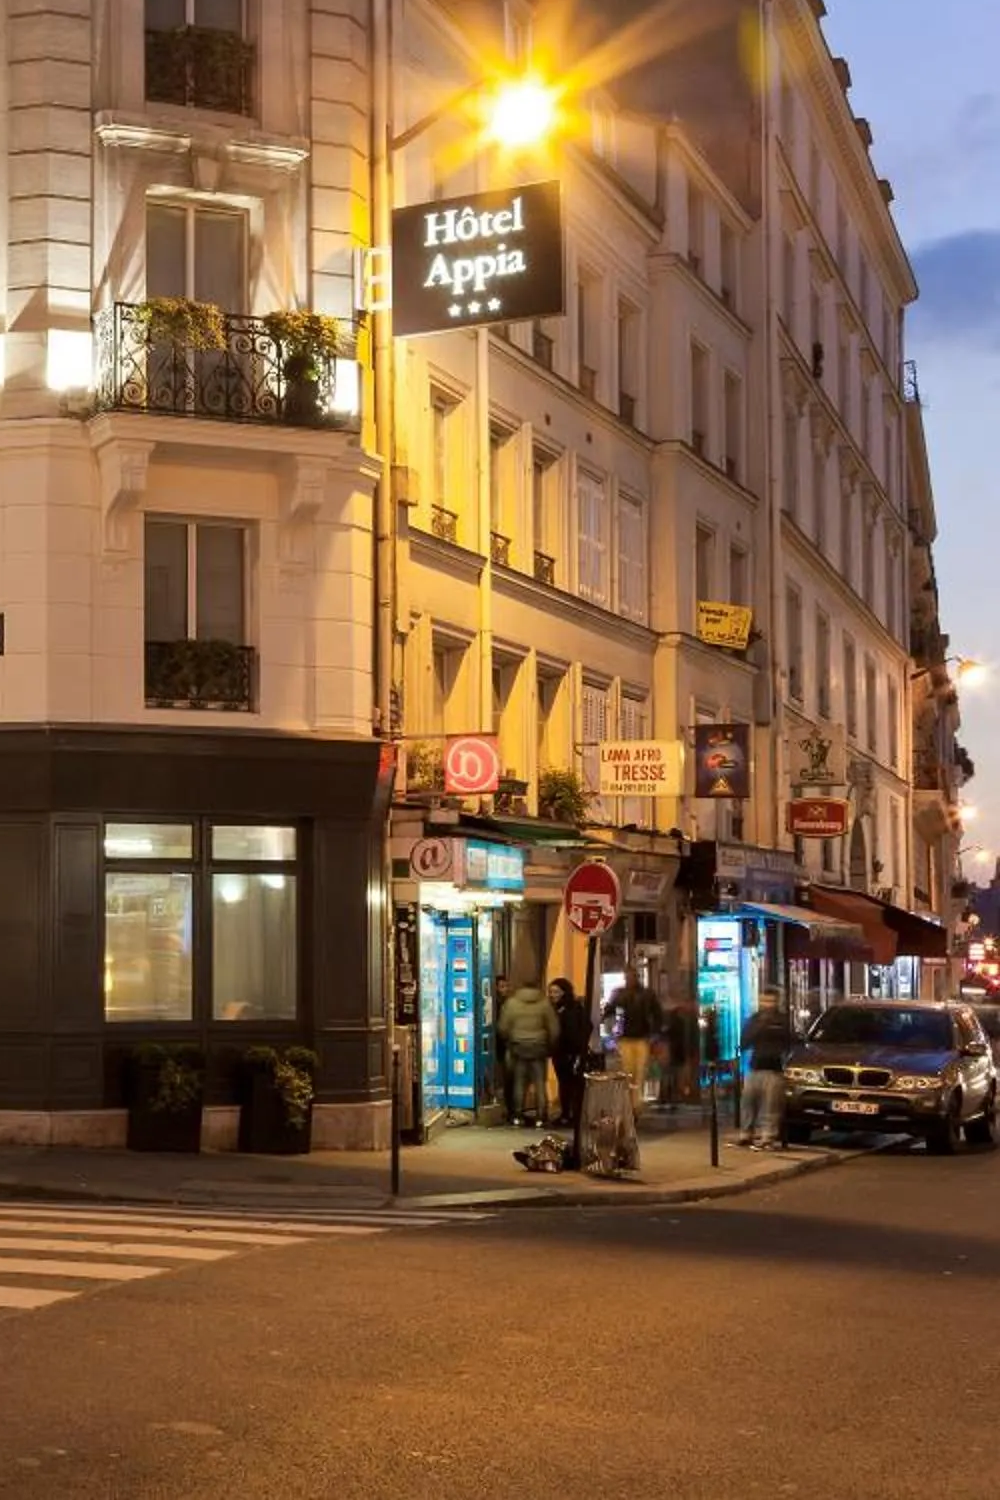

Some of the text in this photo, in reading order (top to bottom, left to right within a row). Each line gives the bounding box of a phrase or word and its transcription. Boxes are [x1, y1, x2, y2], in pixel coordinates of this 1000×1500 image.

[423, 196, 526, 248] Hôtel
[423, 243, 527, 296] Appia
[612, 763, 667, 781] TRESSE
